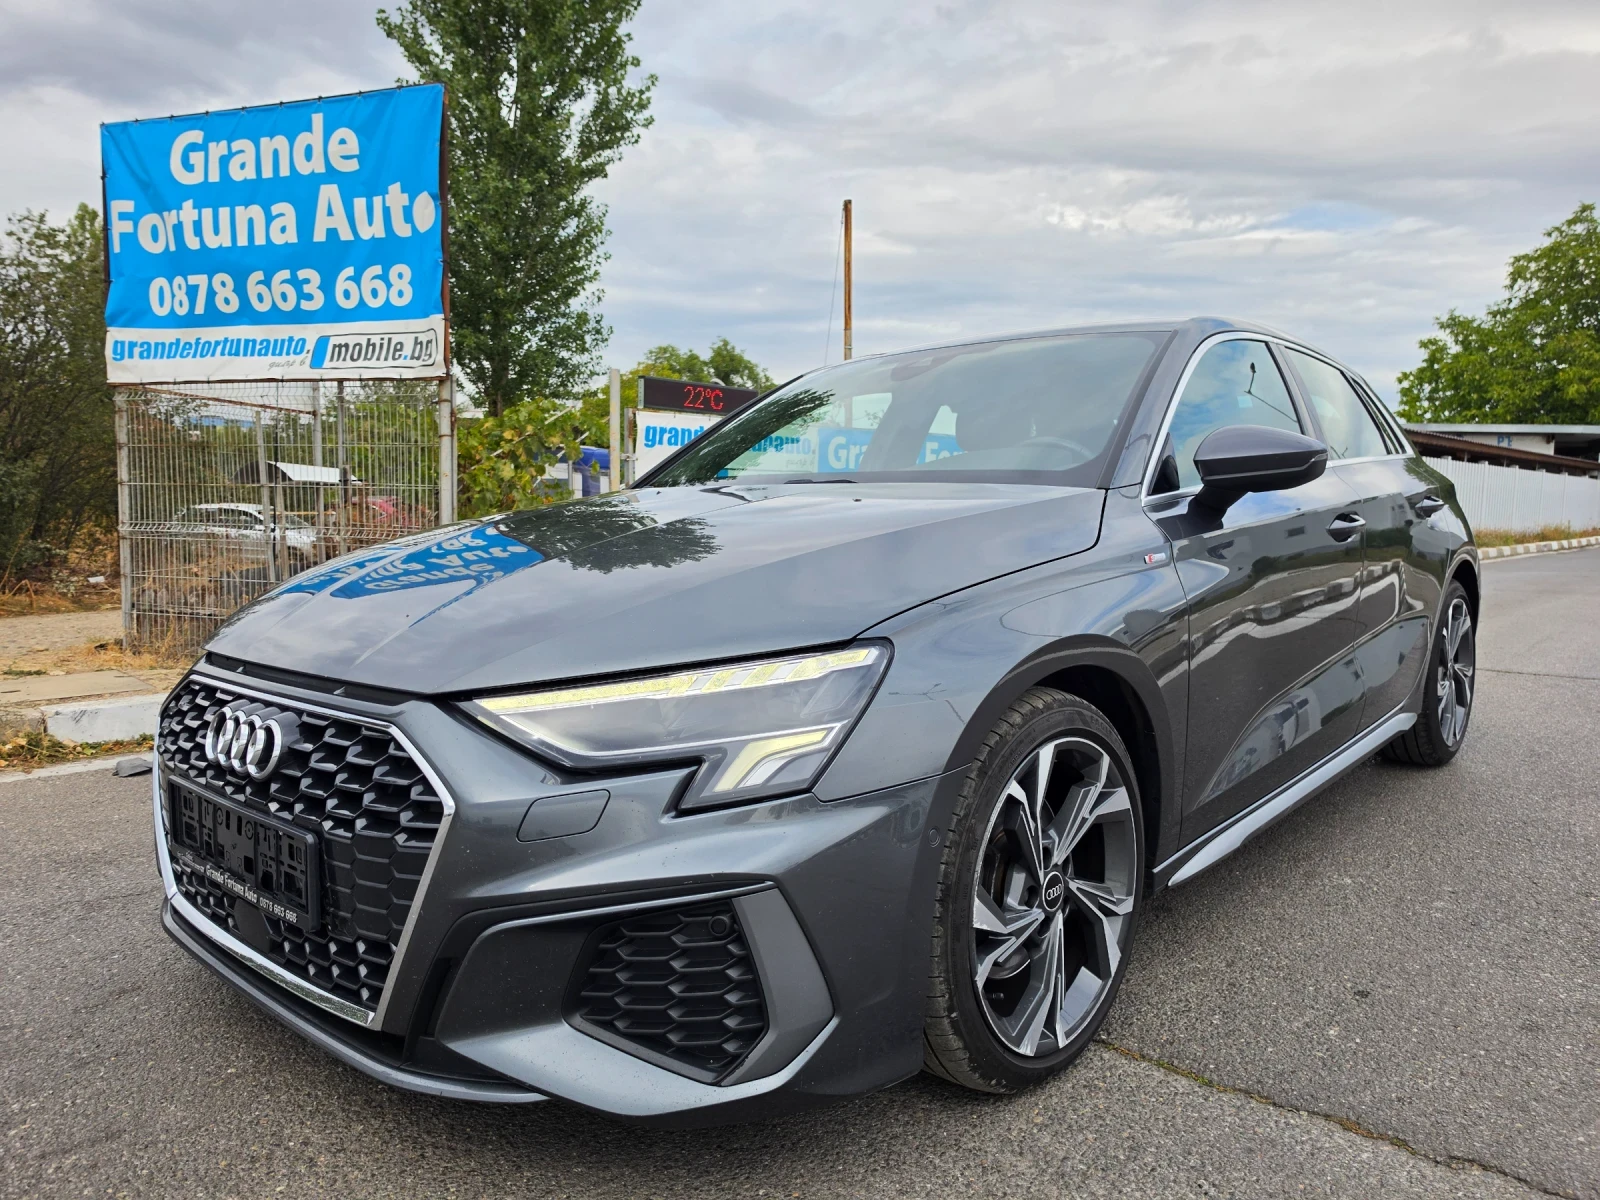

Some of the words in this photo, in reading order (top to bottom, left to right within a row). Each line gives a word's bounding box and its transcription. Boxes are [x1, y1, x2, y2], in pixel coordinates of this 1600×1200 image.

[169, 112, 360, 185] Grande
[110, 198, 298, 254] Fortuna
[313, 182, 436, 242] Auto
[149, 272, 240, 317] 0878
[246, 268, 325, 313] 663
[335, 263, 413, 309] 668
[328, 336, 434, 363] mobile.bg
